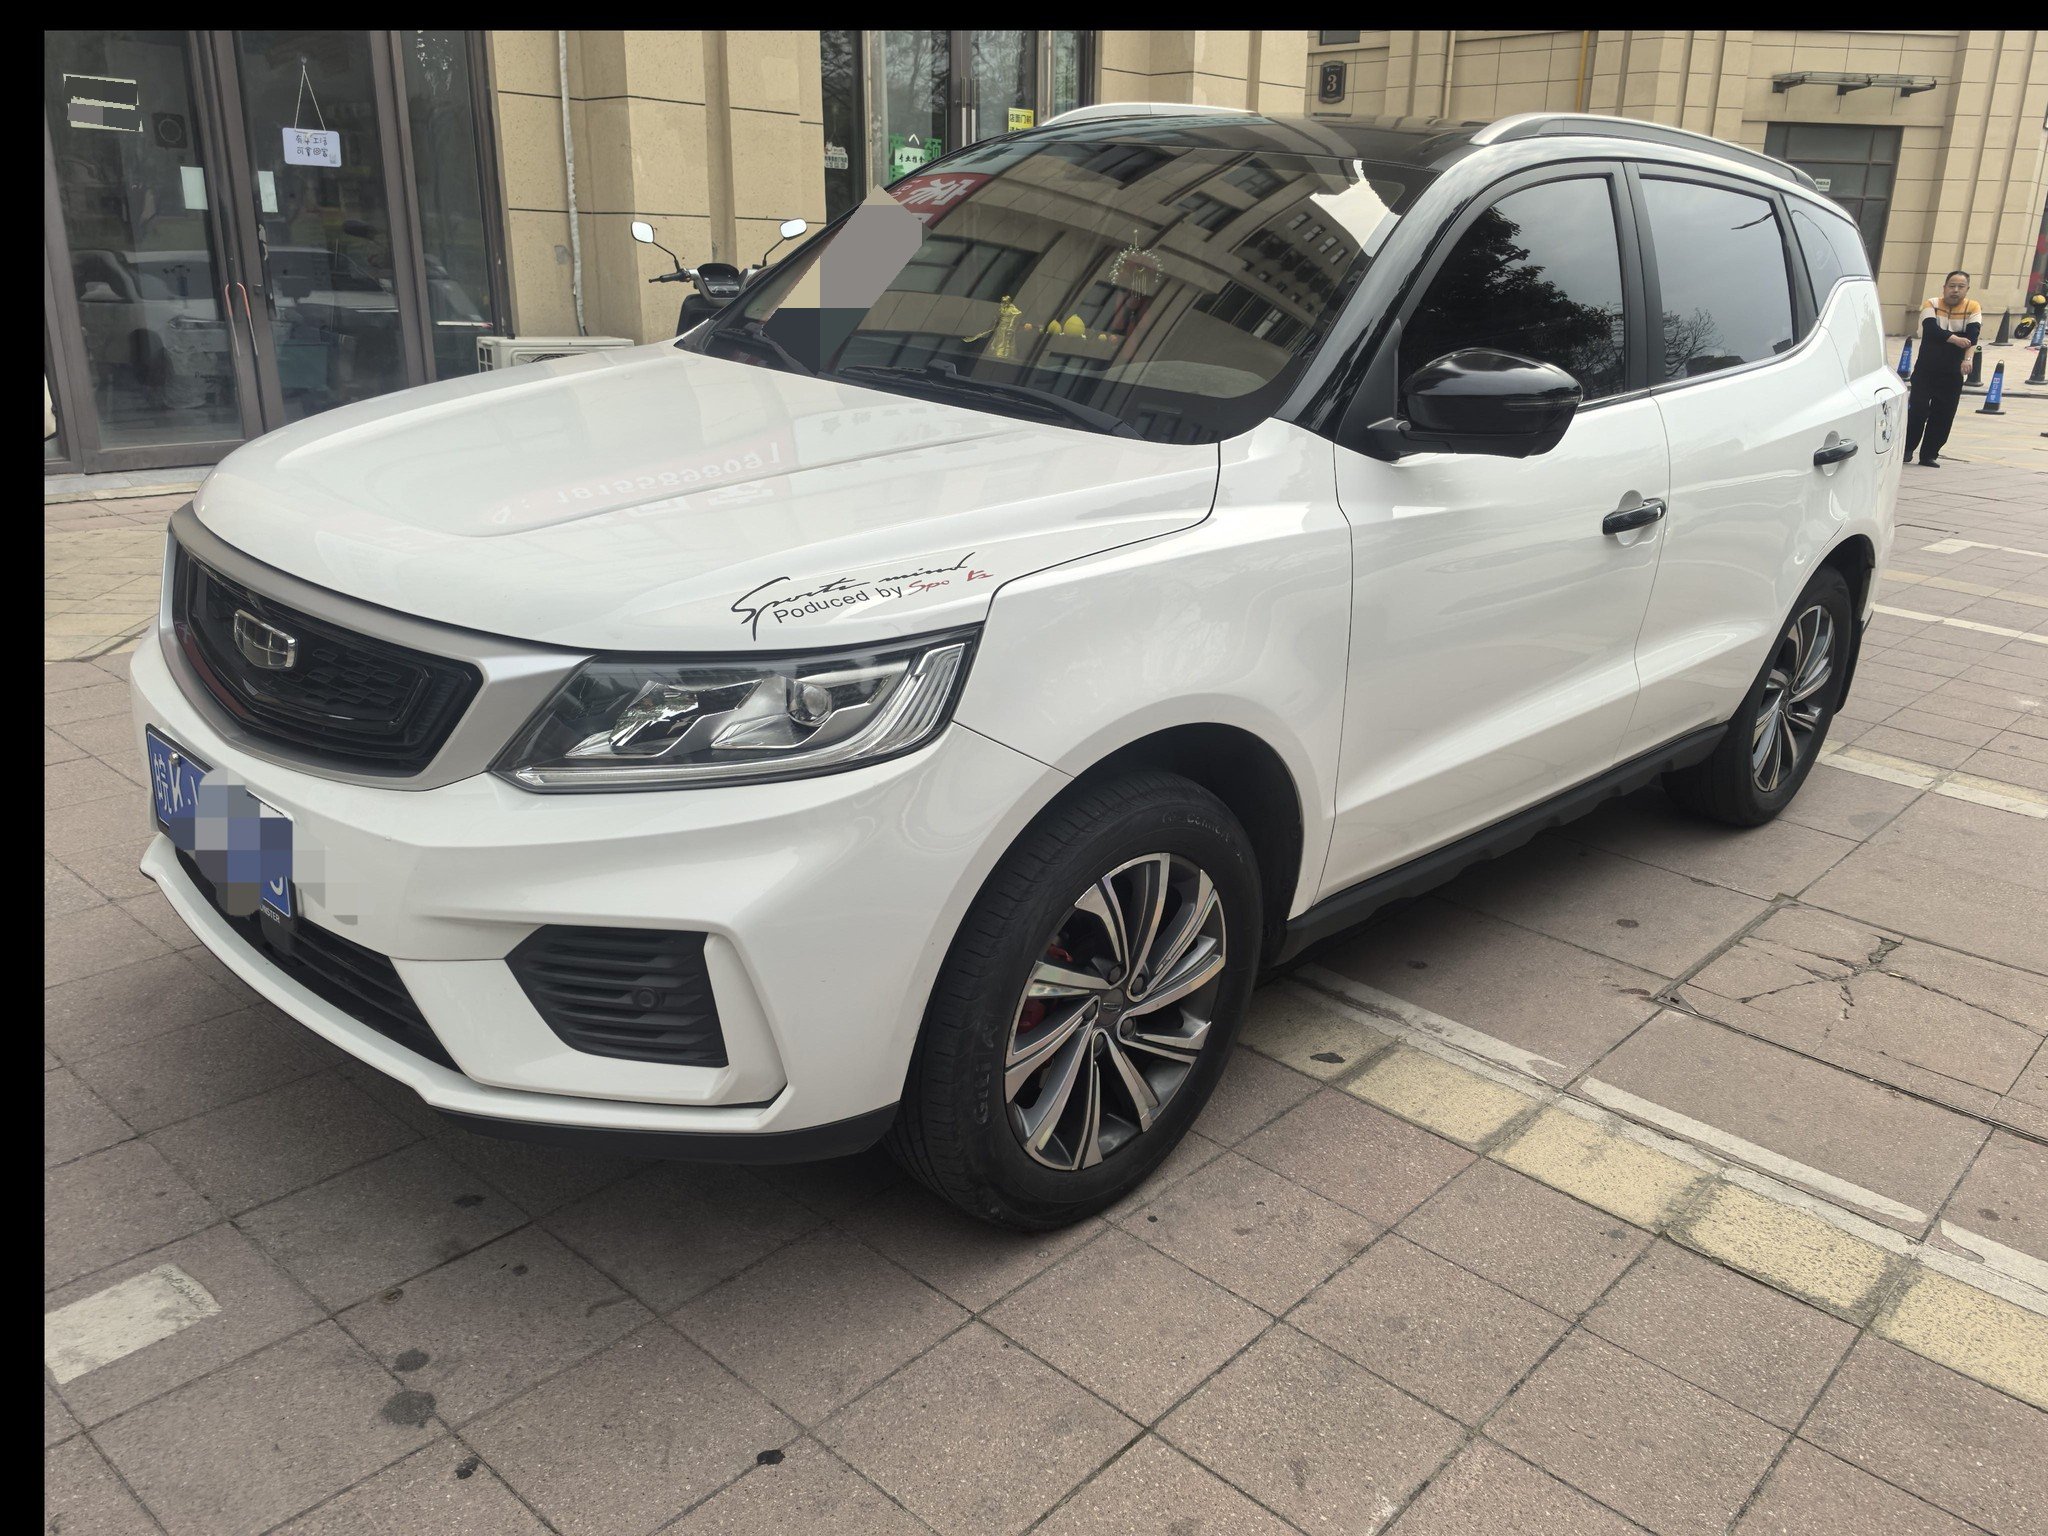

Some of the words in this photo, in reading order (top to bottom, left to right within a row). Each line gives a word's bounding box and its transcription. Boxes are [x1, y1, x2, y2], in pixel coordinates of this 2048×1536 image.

[1327, 74, 1337, 92] 3
[296, 146, 328, 158] 可拿回家
[773, 590, 871, 624] Poduced
[875, 585, 903, 599] by
